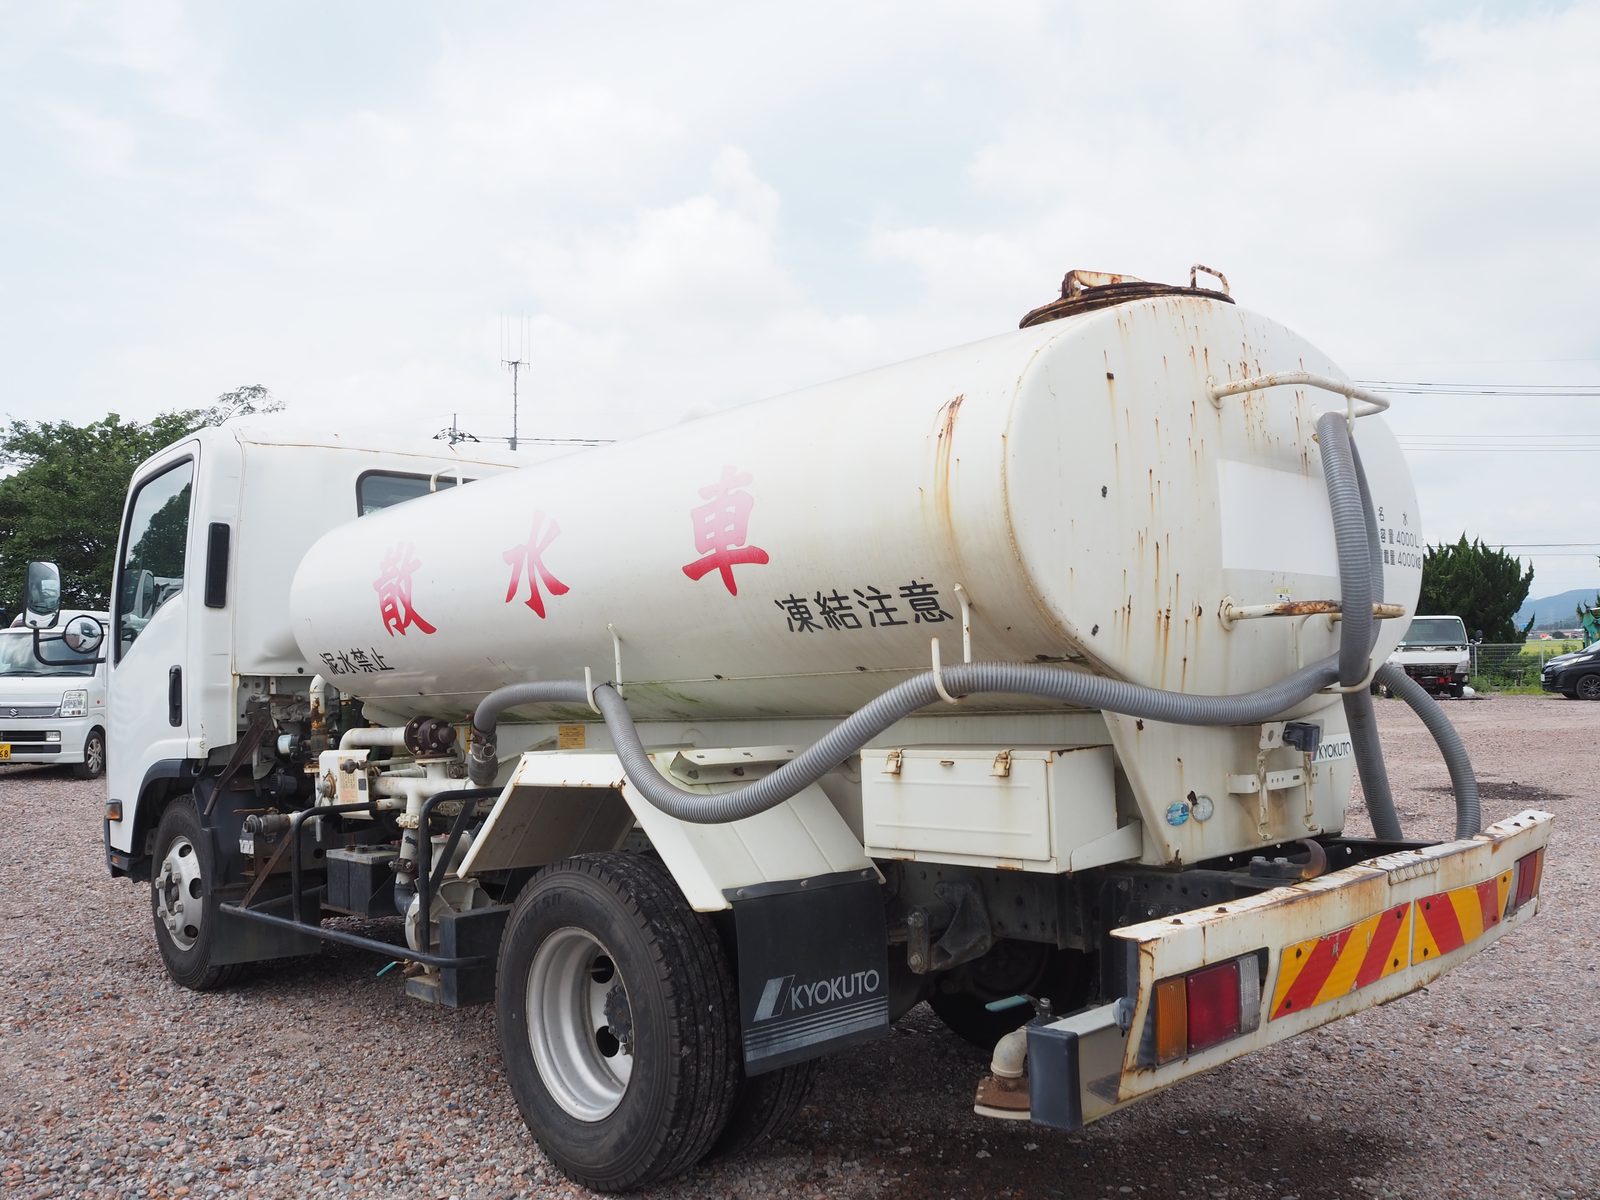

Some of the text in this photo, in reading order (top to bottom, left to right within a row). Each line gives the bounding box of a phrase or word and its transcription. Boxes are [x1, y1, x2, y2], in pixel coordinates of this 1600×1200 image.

[774, 580, 954, 633] 凍結注意
[319, 647, 396, 676] 泥水禁止
[1318, 741, 1352, 760] KYOKUTO
[790, 969, 880, 1011] KYOKUTO
